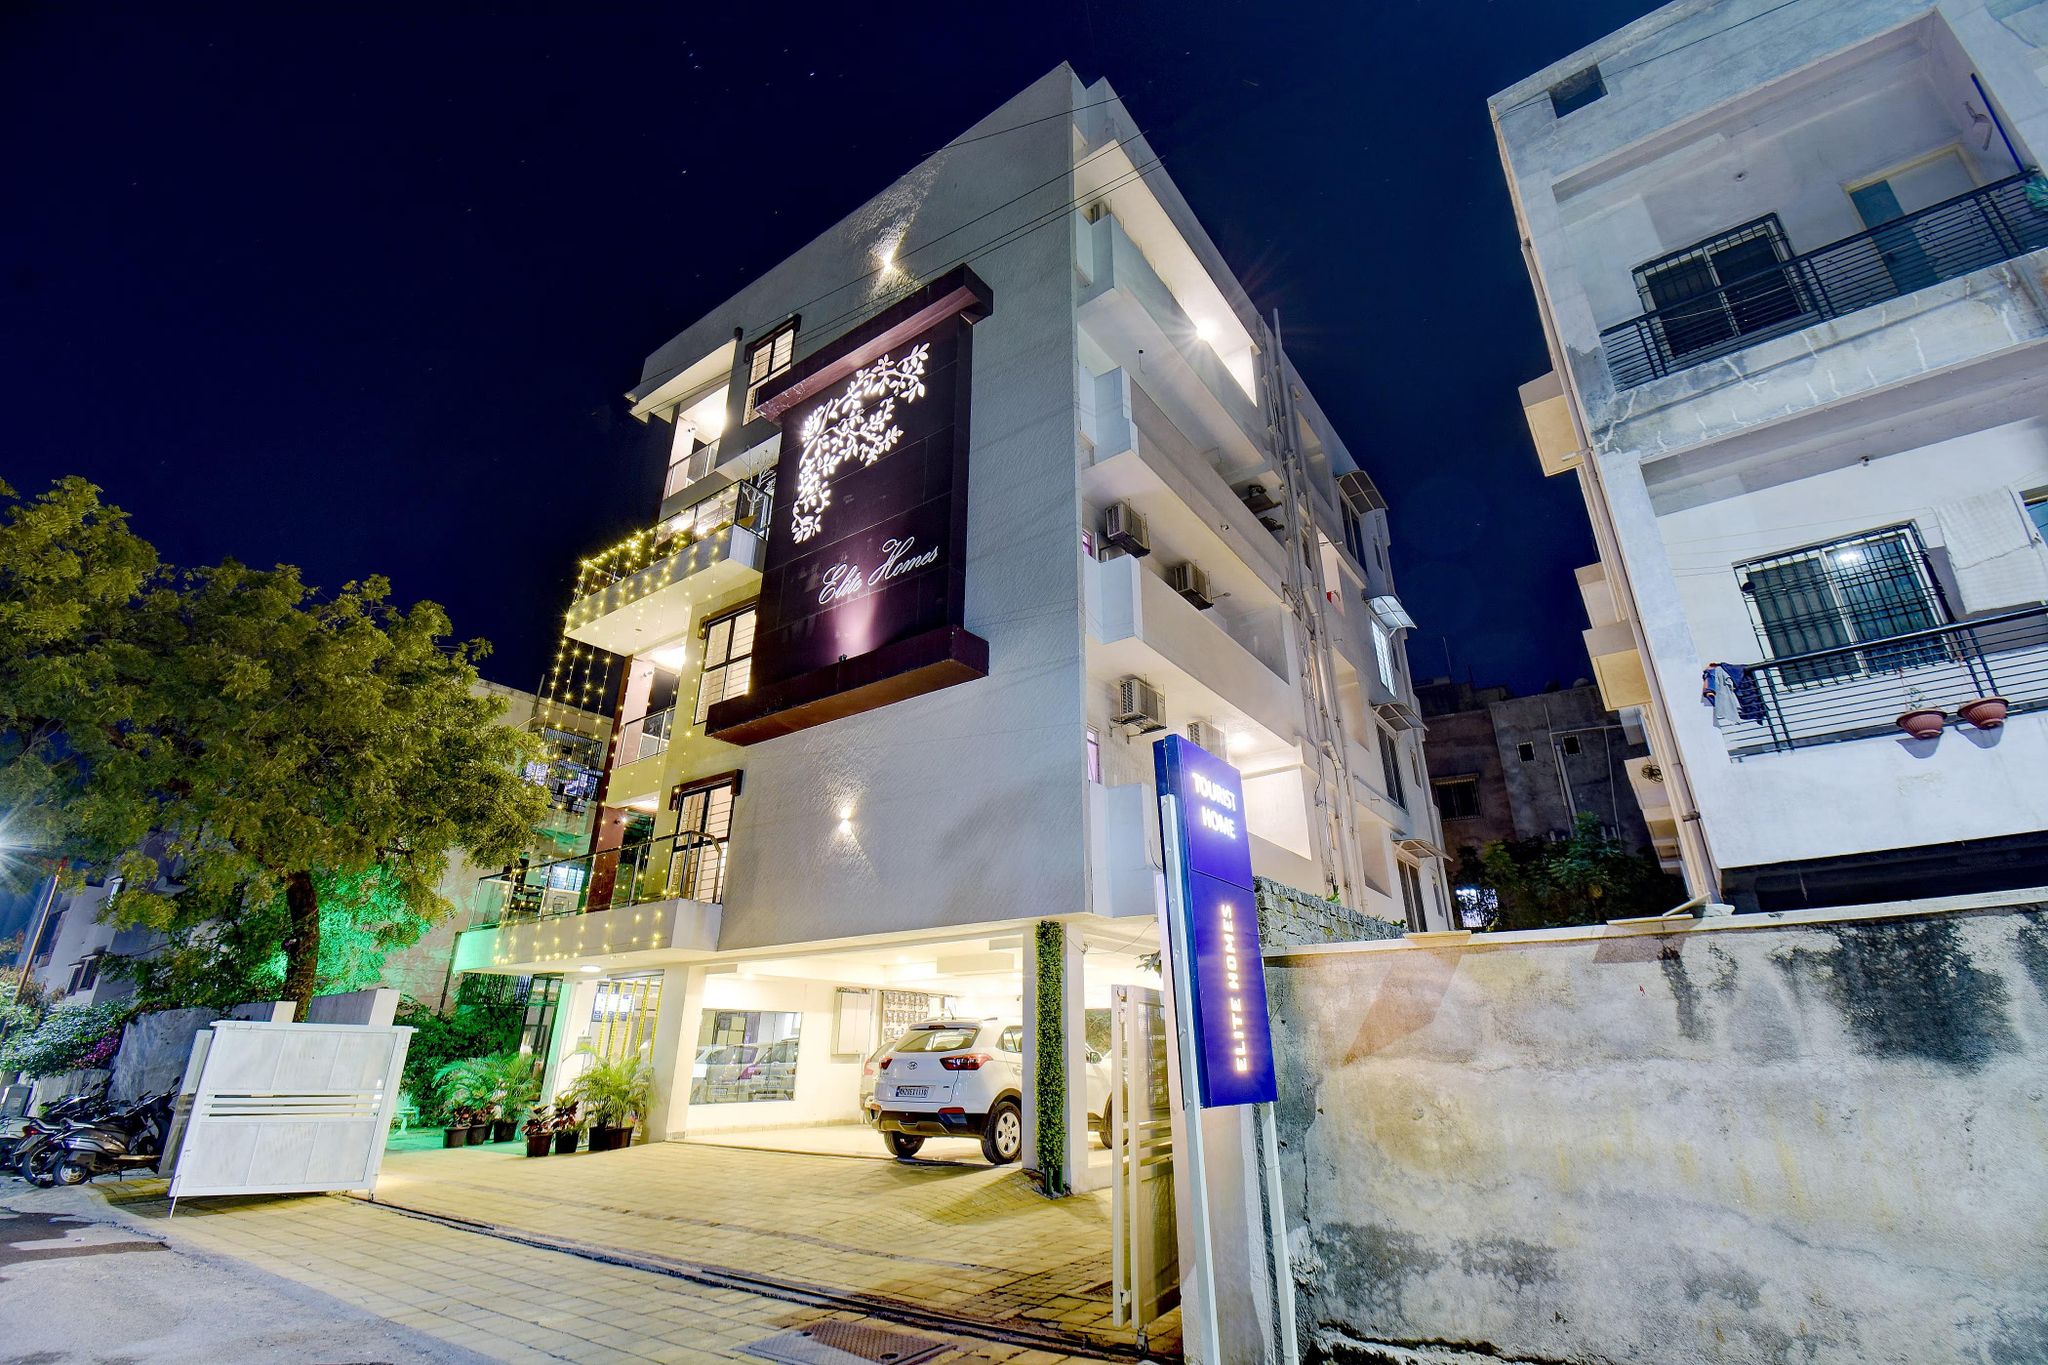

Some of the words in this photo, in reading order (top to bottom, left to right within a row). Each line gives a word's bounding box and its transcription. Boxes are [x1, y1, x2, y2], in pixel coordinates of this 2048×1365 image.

[819, 563, 863, 604] Elite
[868, 536, 939, 586] Homes
[1192, 773, 1236, 811] TOURIST
[1202, 806, 1236, 840] HOME
[1221, 904, 1239, 990] HOMES
[1231, 998, 1247, 1072] ELITE
